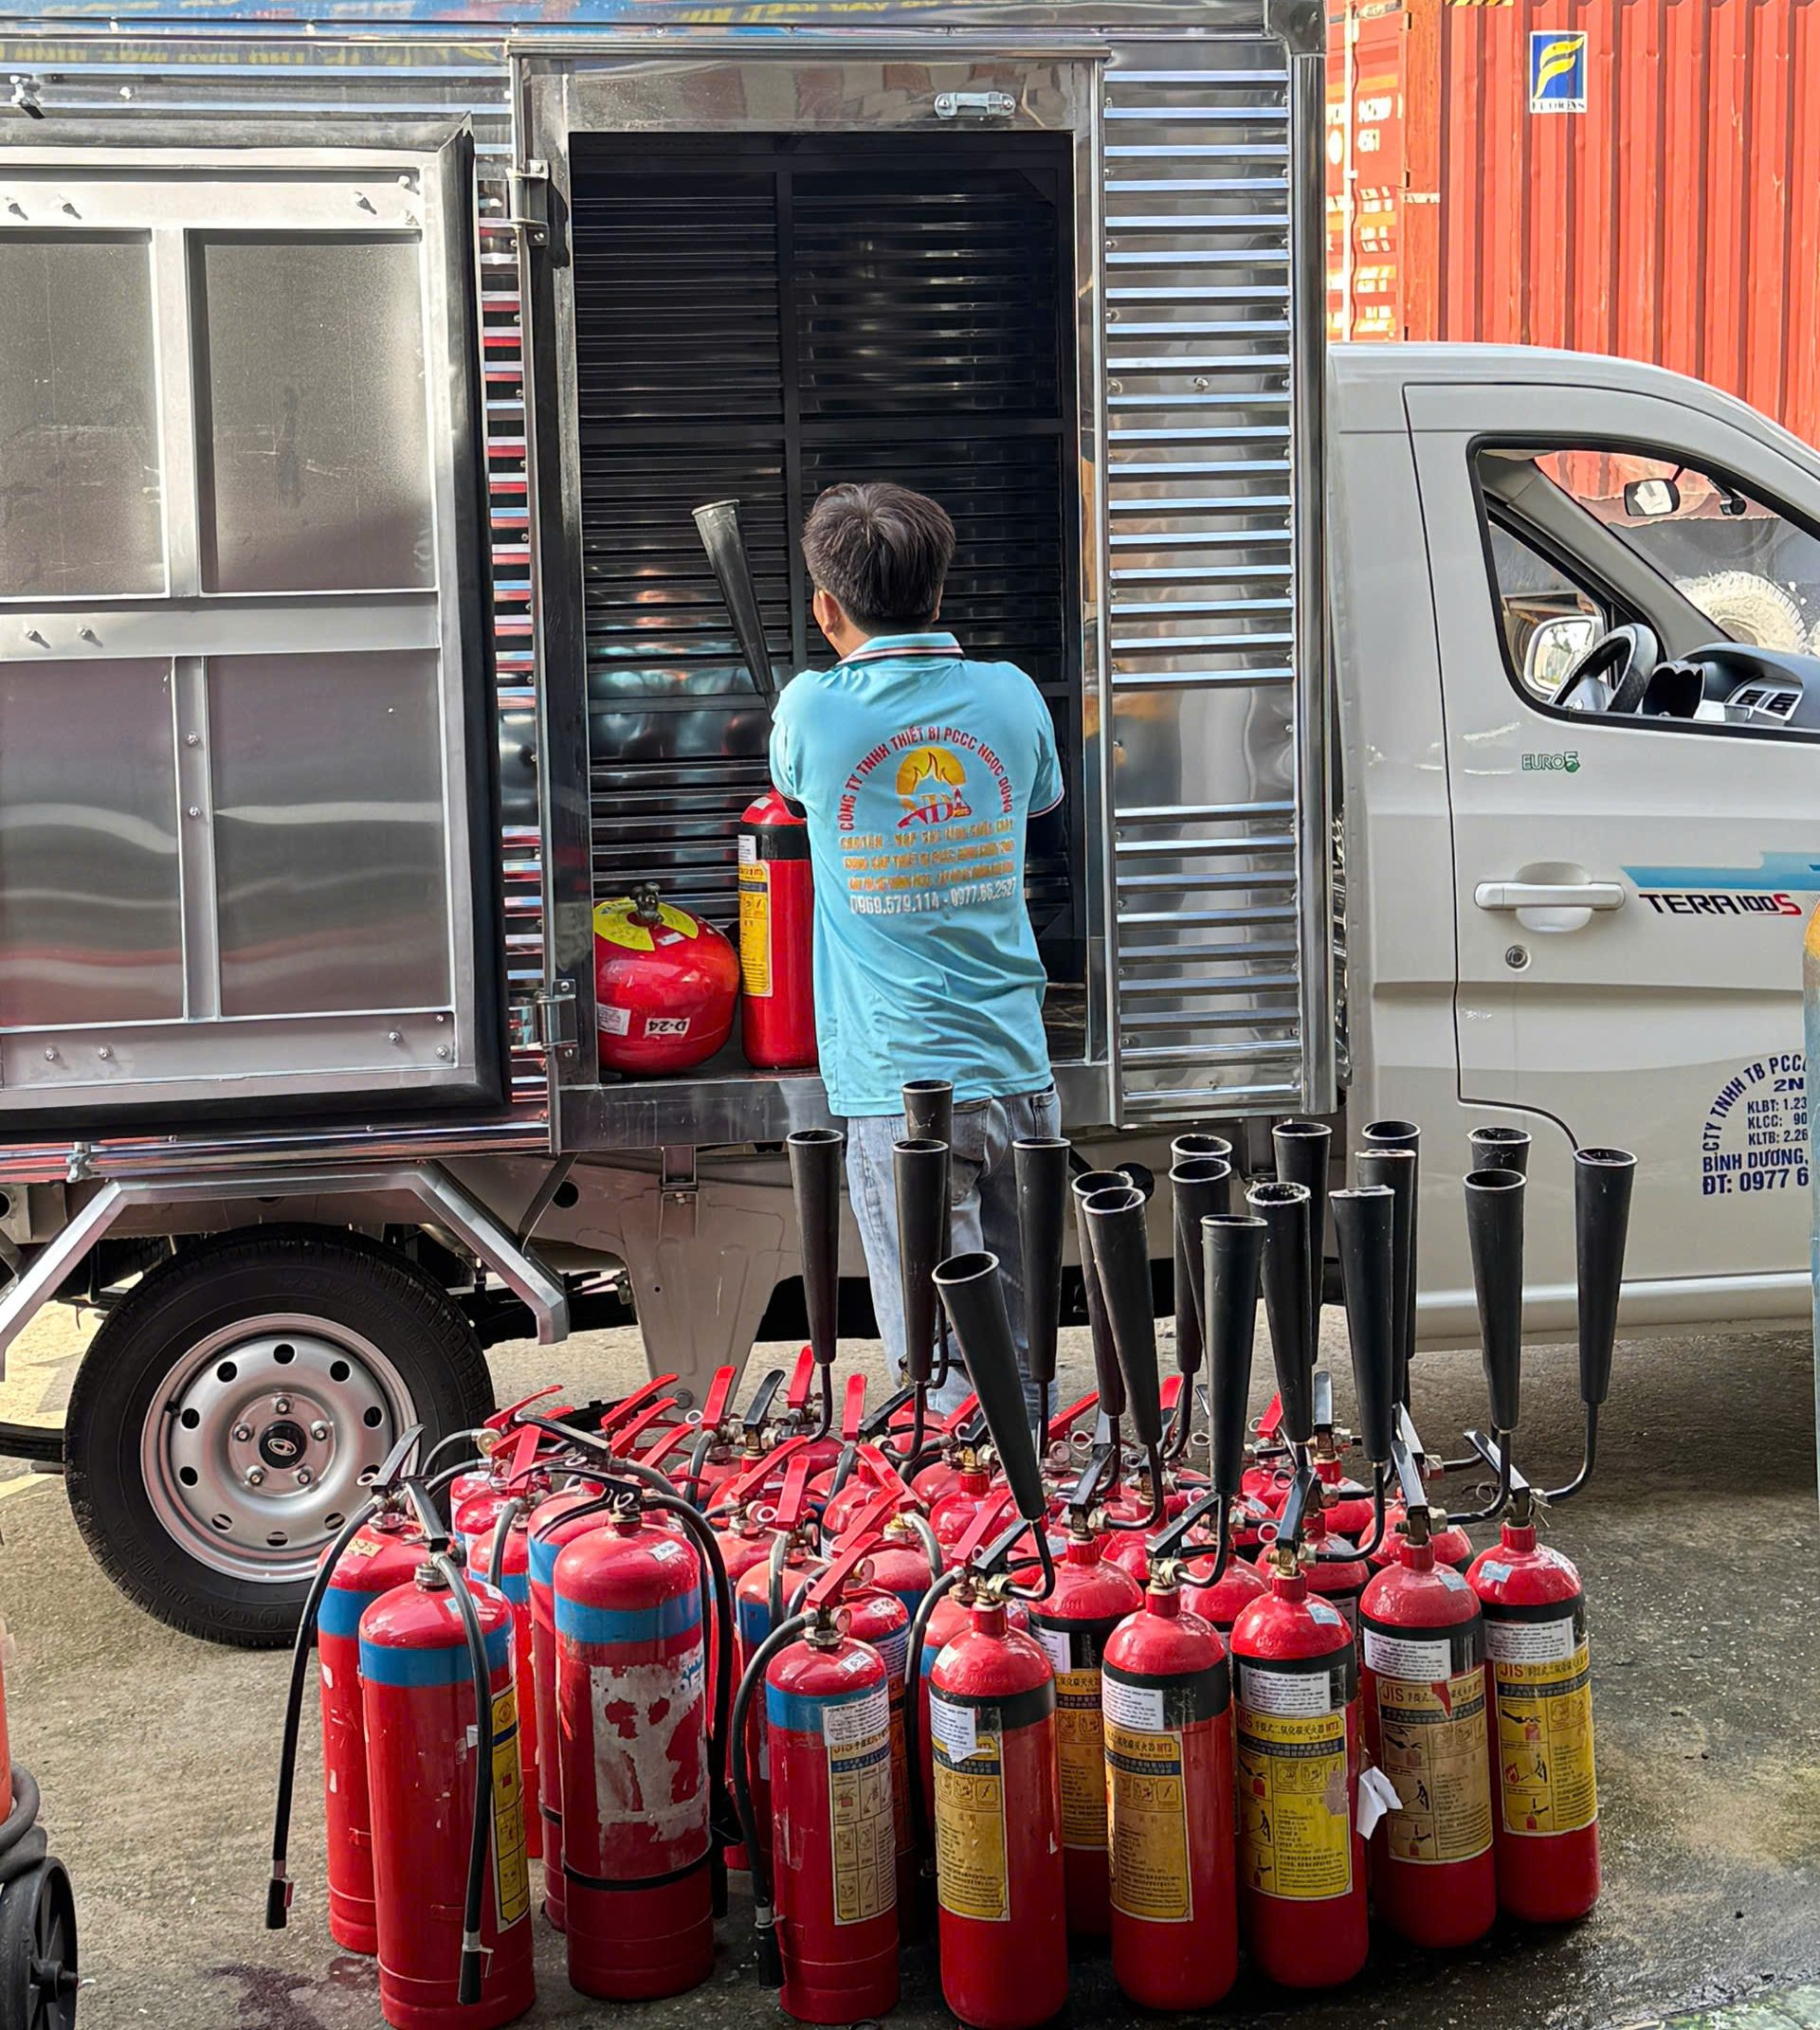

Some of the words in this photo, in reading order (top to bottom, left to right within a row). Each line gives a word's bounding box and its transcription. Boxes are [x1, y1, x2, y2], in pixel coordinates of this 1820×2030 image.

[845, 772, 864, 791] TY
[855, 742, 892, 775] TNHH
[943, 727, 978, 751] PCCC
[1521, 751, 1580, 773] EURO5
[1743, 1062, 1766, 1084] TB
[1709, 1077, 1747, 1119] TNHH
[1747, 1099, 1779, 1114] KLBT:
[1747, 1115, 1783, 1130] KLCC:
[1702, 1122, 1722, 1151] CTY
[1748, 1132, 1780, 1146] KLTB:
[1702, 1152, 1742, 1173] BÌNH
[1747, 1148, 1809, 1169] DƯƠNG,
[1702, 1174, 1733, 1195] ĐT:
[1739, 1169, 1790, 1192] 0977
[1501, 1663, 1524, 1677] JIS
[1383, 1685, 1404, 1702] JIS
